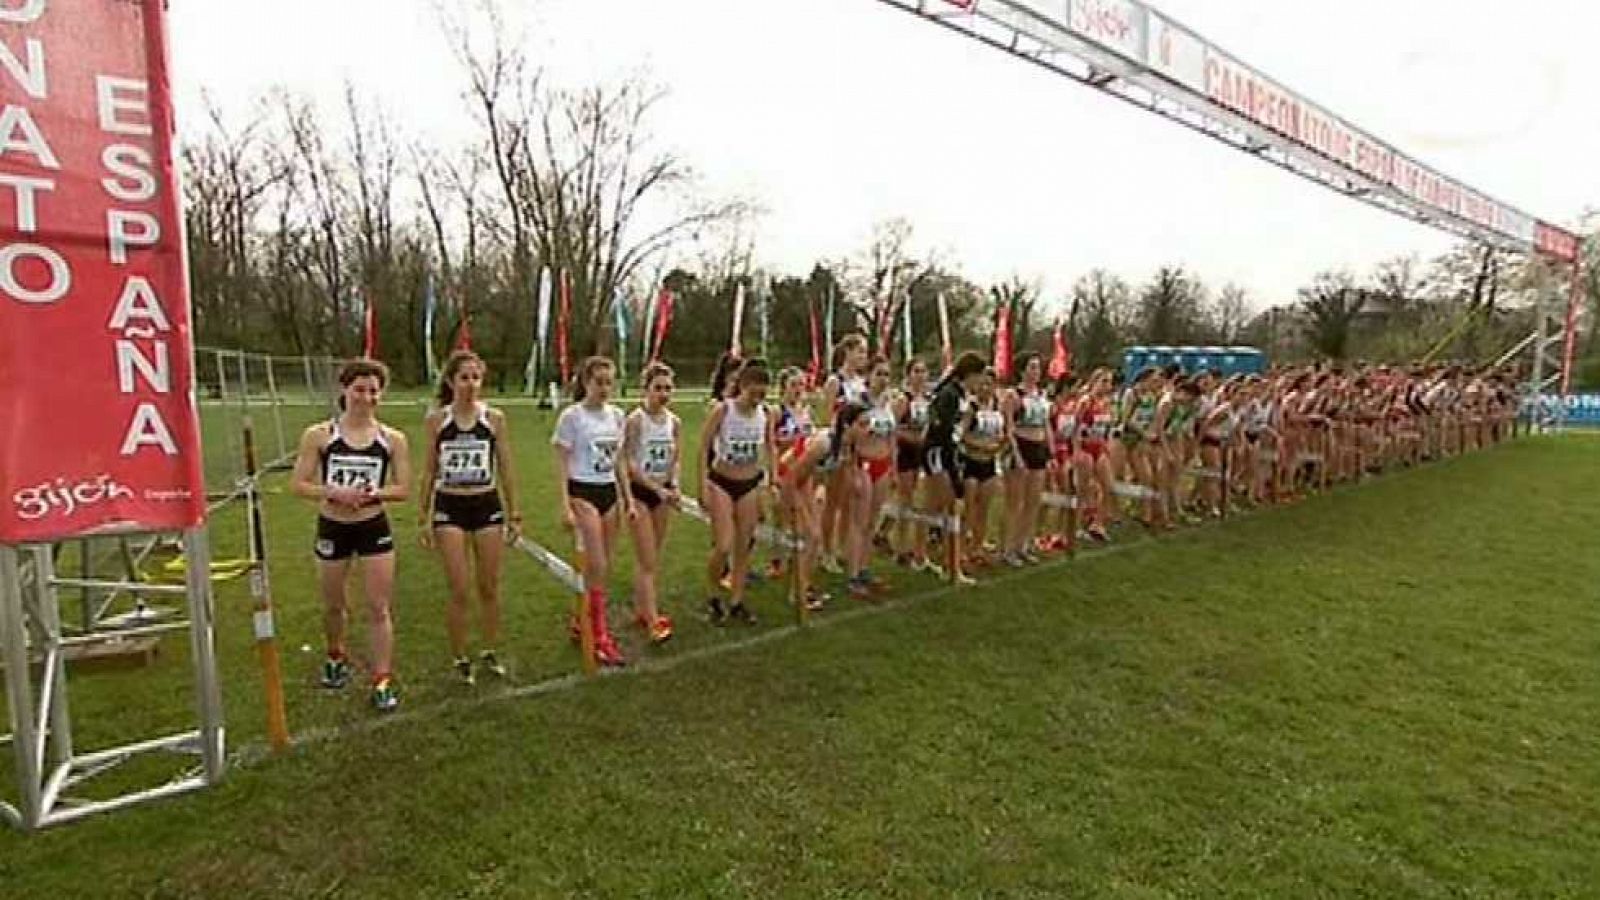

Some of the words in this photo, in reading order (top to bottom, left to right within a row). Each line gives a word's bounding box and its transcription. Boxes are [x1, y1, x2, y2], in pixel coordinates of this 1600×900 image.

[97, 75, 178, 454] ESPAÑA
[447, 452, 481, 467] 474
[13, 473, 134, 519] gijón
